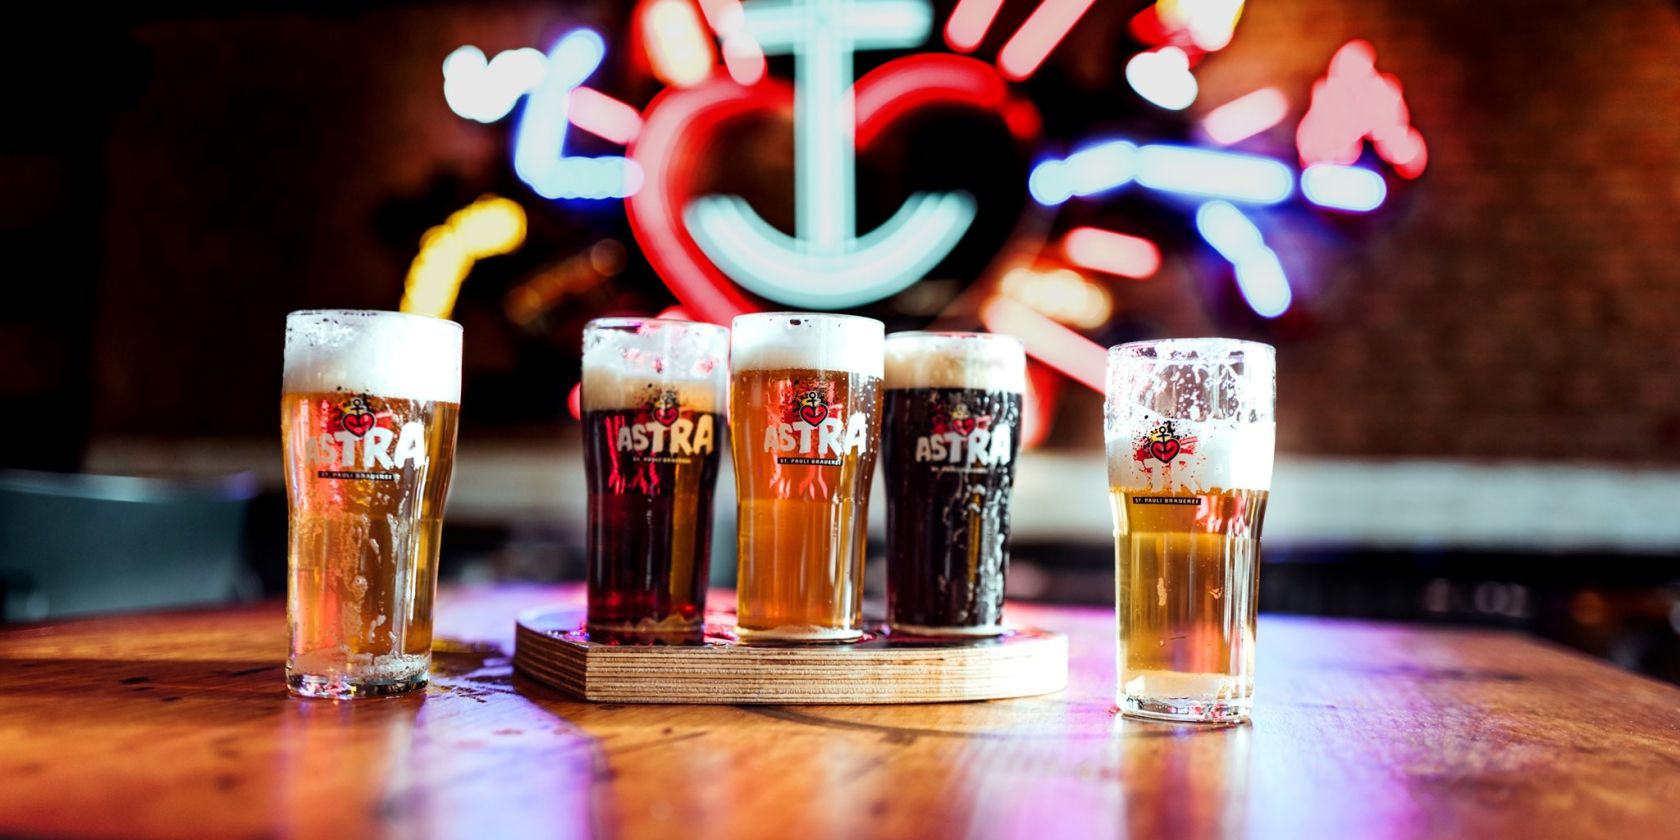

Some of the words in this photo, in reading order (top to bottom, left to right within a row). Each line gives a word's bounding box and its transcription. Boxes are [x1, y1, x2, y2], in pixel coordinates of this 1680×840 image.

[305, 418, 426, 471] ASTRA
[617, 414, 714, 456] ASTRA
[763, 410, 866, 458] ASTRA
[915, 422, 1011, 466] ASTRA
[1164, 497, 1199, 505] BRAUEREI
